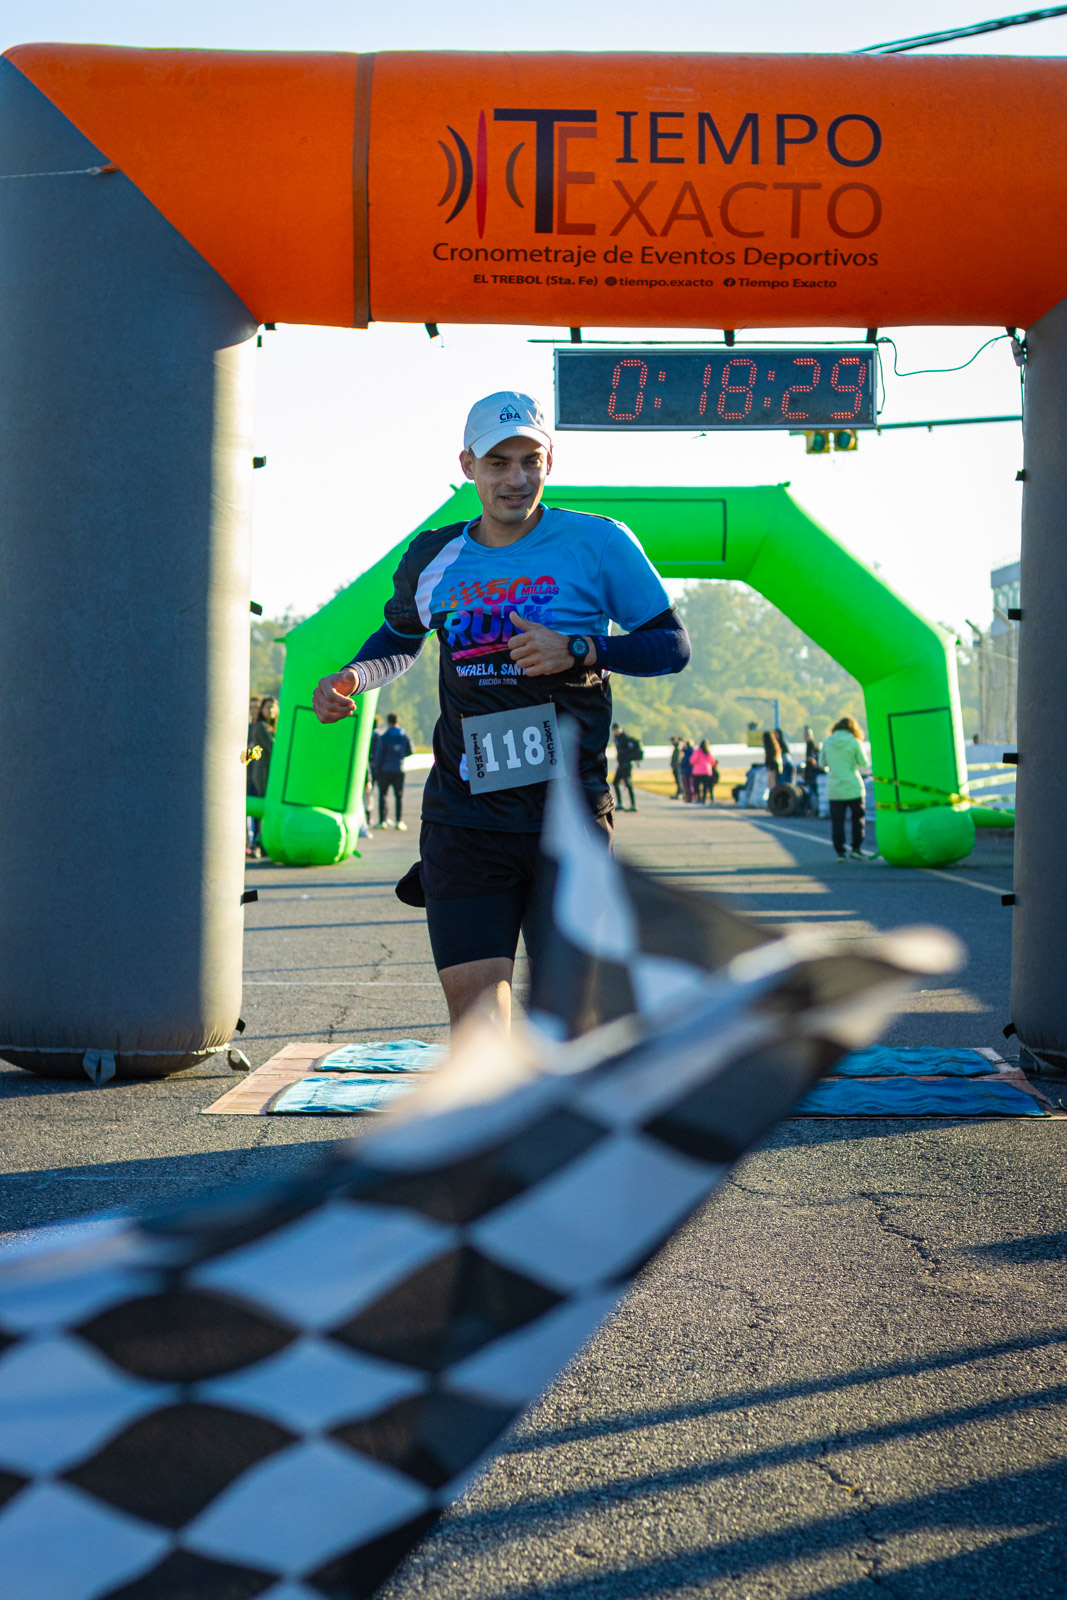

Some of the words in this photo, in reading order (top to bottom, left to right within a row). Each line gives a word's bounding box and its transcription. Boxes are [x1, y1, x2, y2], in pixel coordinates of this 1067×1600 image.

[432, 242, 597, 267] Cronometraje
[603, 244, 633, 264] de
[640, 246, 736, 265] Eventos
[743, 247, 879, 270] Deportivos
[473, 274, 489, 284] EL
[491, 274, 543, 285] TREBOL
[545, 275, 576, 286] (Sta.
[578, 276, 598, 286] Fe)
[619, 276, 714, 288] tiempo.exacto
[738, 277, 789, 290] Tiempo
[792, 278, 837, 288] Exacto
[608, 358, 867, 420] 0:18:29
[499, 412, 521, 421] CBA
[521, 586, 559, 595] MILLAS
[470, 733, 485, 778] TIEMPO
[482, 726, 545, 773] 118
[543, 720, 557, 766] EXACTO
